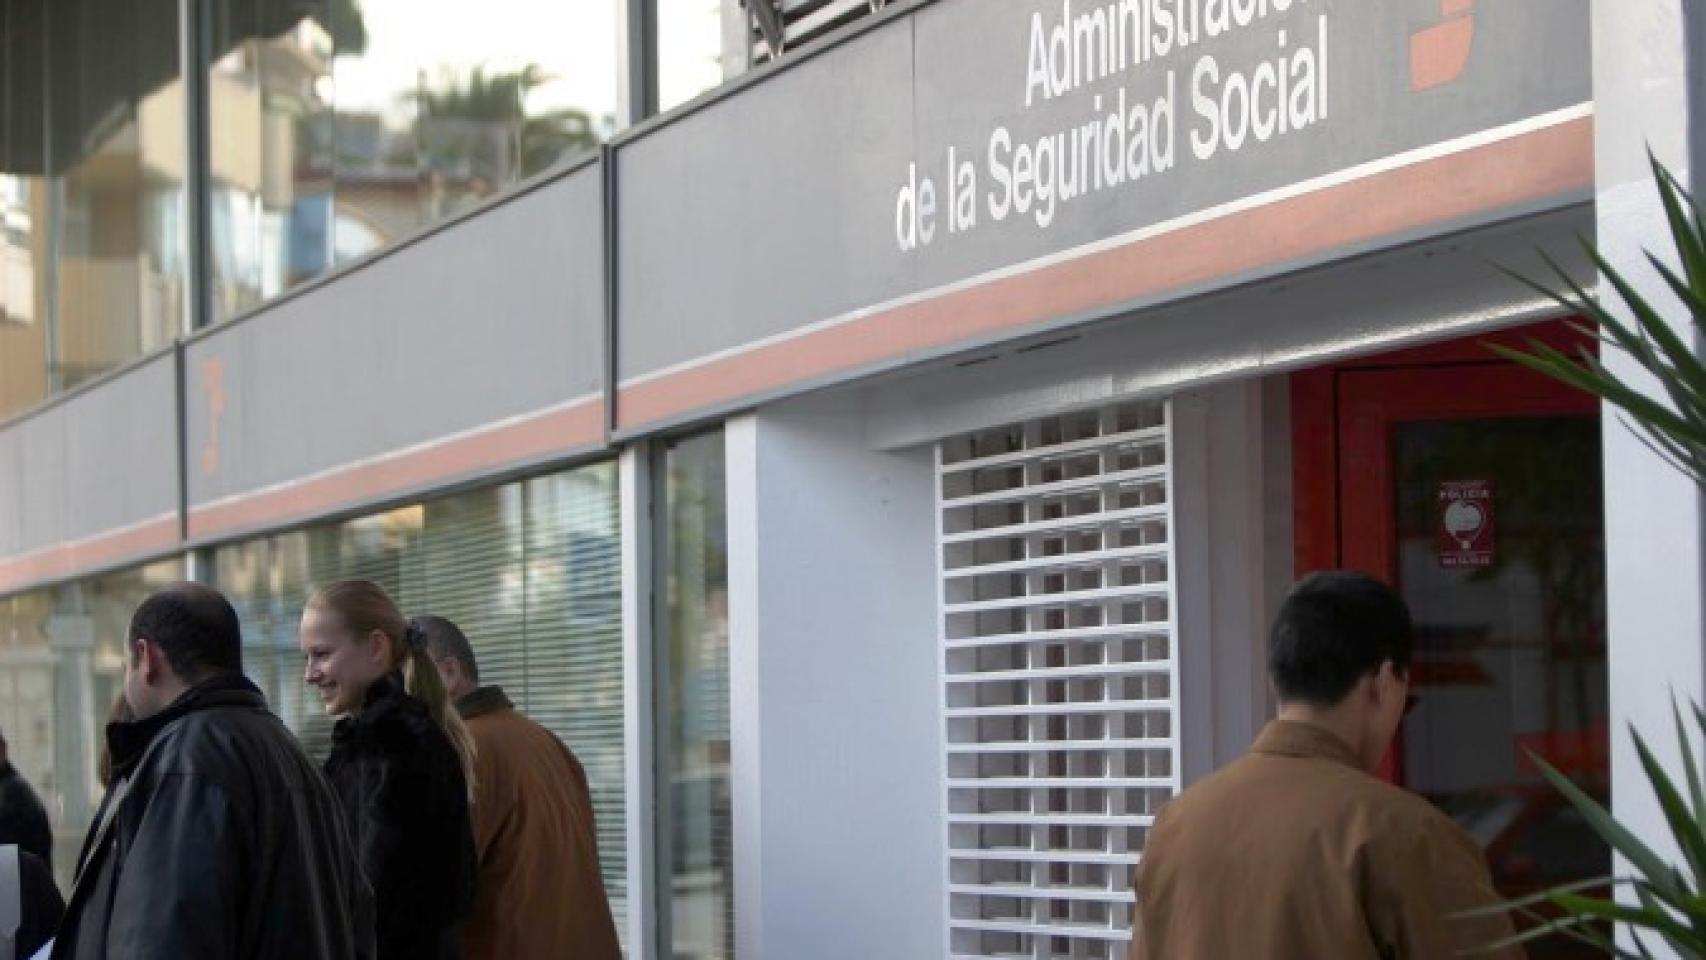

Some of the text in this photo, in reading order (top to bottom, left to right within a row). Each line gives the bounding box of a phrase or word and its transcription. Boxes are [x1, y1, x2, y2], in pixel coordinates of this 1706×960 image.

[897, 15, 1328, 250] de la Seguridad Social
[1026, 0, 1306, 106] Administr
